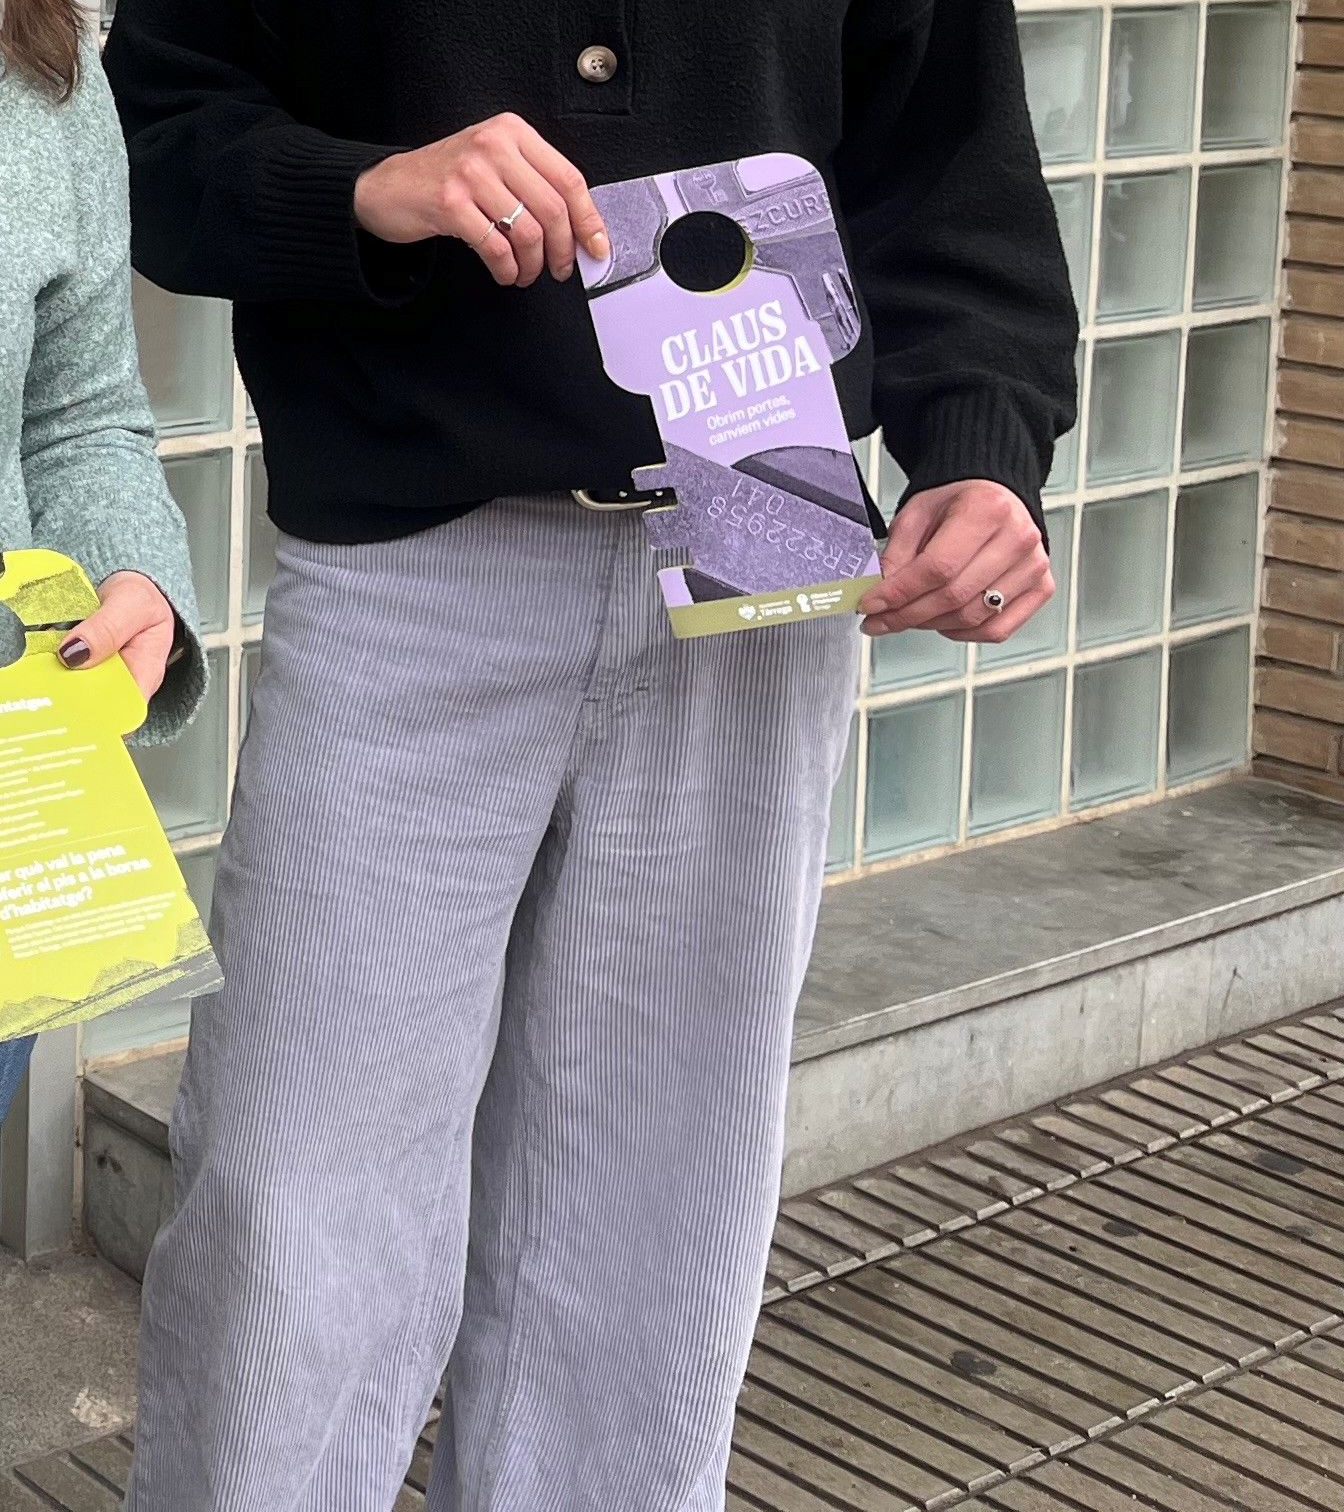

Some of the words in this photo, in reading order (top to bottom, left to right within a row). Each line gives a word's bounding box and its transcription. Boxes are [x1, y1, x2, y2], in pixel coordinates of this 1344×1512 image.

[661, 300, 787, 375] CLAUS
[659, 369, 717, 422] DE
[721, 336, 822, 397] VIDA
[707, 410, 746, 429] Obrim
[747, 395, 790, 420] portes,
[709, 420, 762, 446] canviem
[764, 408, 796, 427] vides
